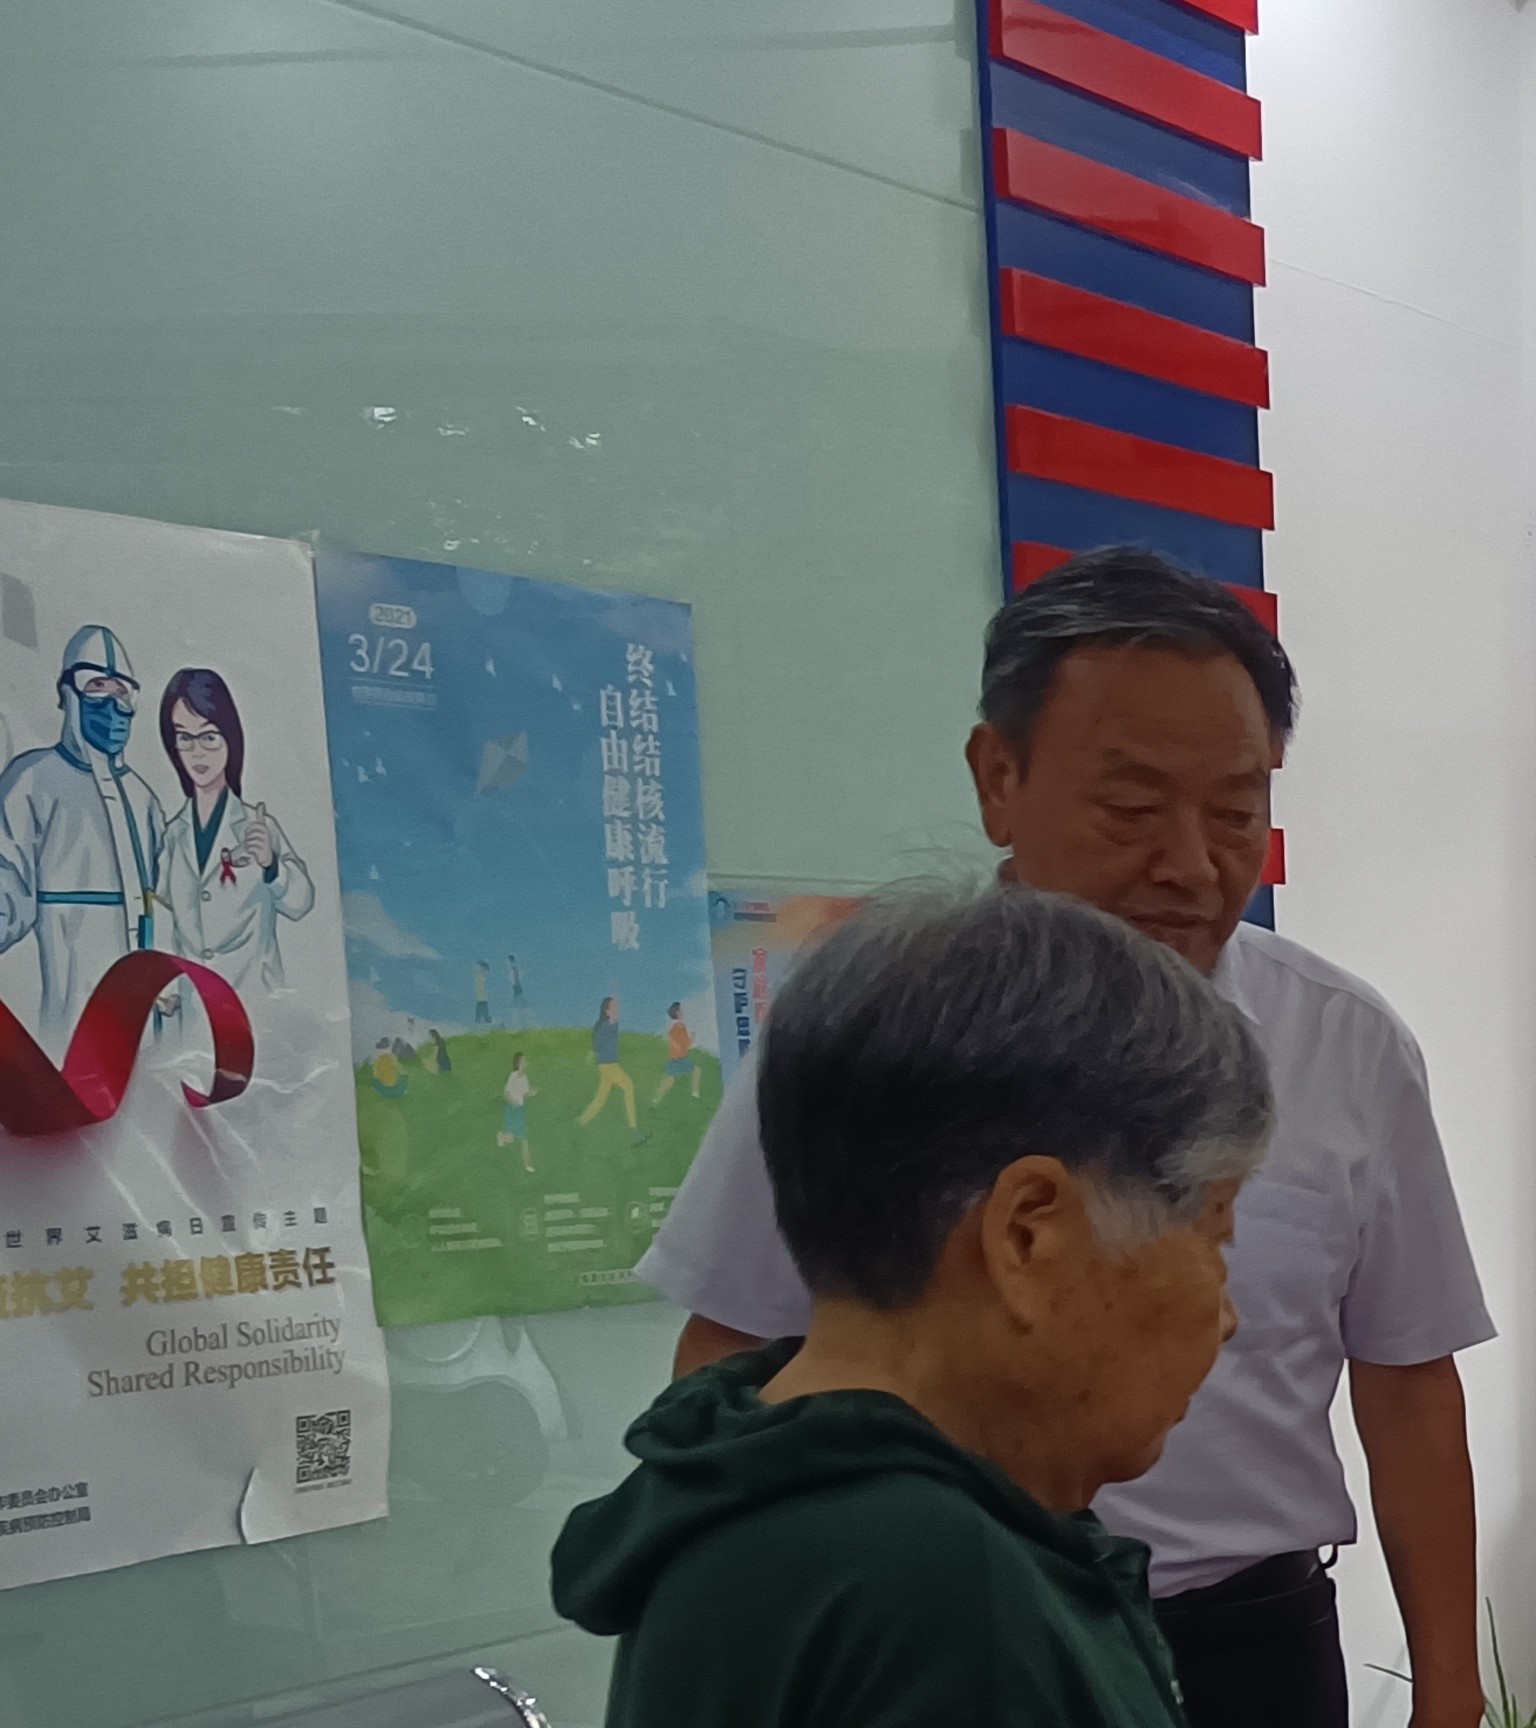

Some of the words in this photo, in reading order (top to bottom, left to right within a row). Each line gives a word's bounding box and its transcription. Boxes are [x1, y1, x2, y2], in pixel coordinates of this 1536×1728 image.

[348, 633, 434, 679] 3/24
[625, 643, 669, 909] 终结结核流行
[600, 684, 640, 950] 自由健康呼吸
[0, 1265, 94, 1319] 抗艾
[120, 1247, 336, 1307] 共担健康责任
[146, 1323, 229, 1357] Global
[236, 1313, 342, 1347] Solidarity
[87, 1363, 174, 1399] Shared
[184, 1347, 347, 1389] Responsibility
